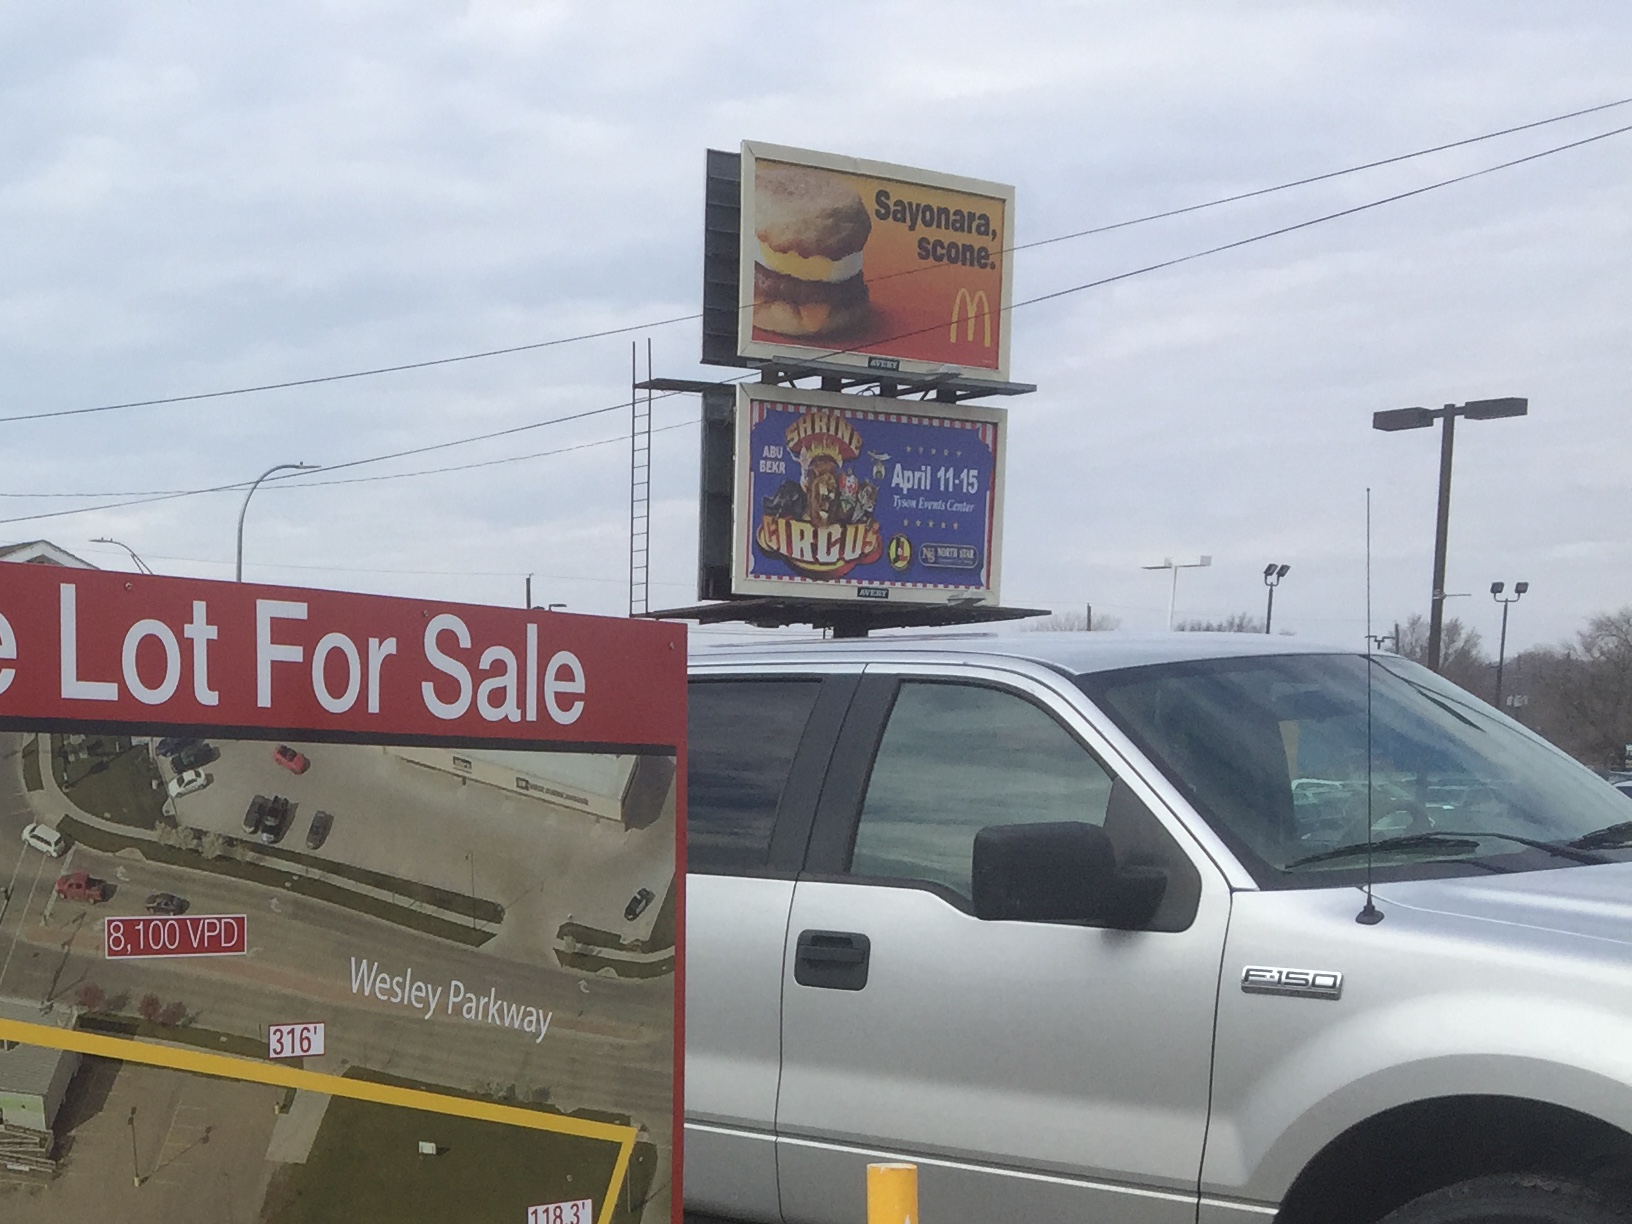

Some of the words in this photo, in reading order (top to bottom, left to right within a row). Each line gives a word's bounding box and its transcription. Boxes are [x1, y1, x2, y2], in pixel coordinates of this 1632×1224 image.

[875, 189, 997, 242] Sayonara,
[917, 237, 996, 270] scone.
[785, 412, 863, 450] SHRINE
[759, 460, 786, 475] BEKR
[763, 445, 783, 458] ABU
[891, 463, 930, 494] April
[937, 466, 978, 494] 11-15
[893, 496, 917, 509] Tyson
[918, 498, 945, 511] Events
[946, 501, 975, 513] Center
[760, 514, 879, 563] CIRCUS
[59, 583, 219, 707] Lot
[256, 600, 396, 715] For
[421, 613, 586, 725] Sale
[109, 920, 178, 953] 8,100
[185, 918, 239, 948] VPD
[1244, 968, 1338, 988] F-150
[349, 956, 442, 1019] Wesley
[448, 981, 552, 1043] Parkway
[272, 1026, 318, 1056] 316'
